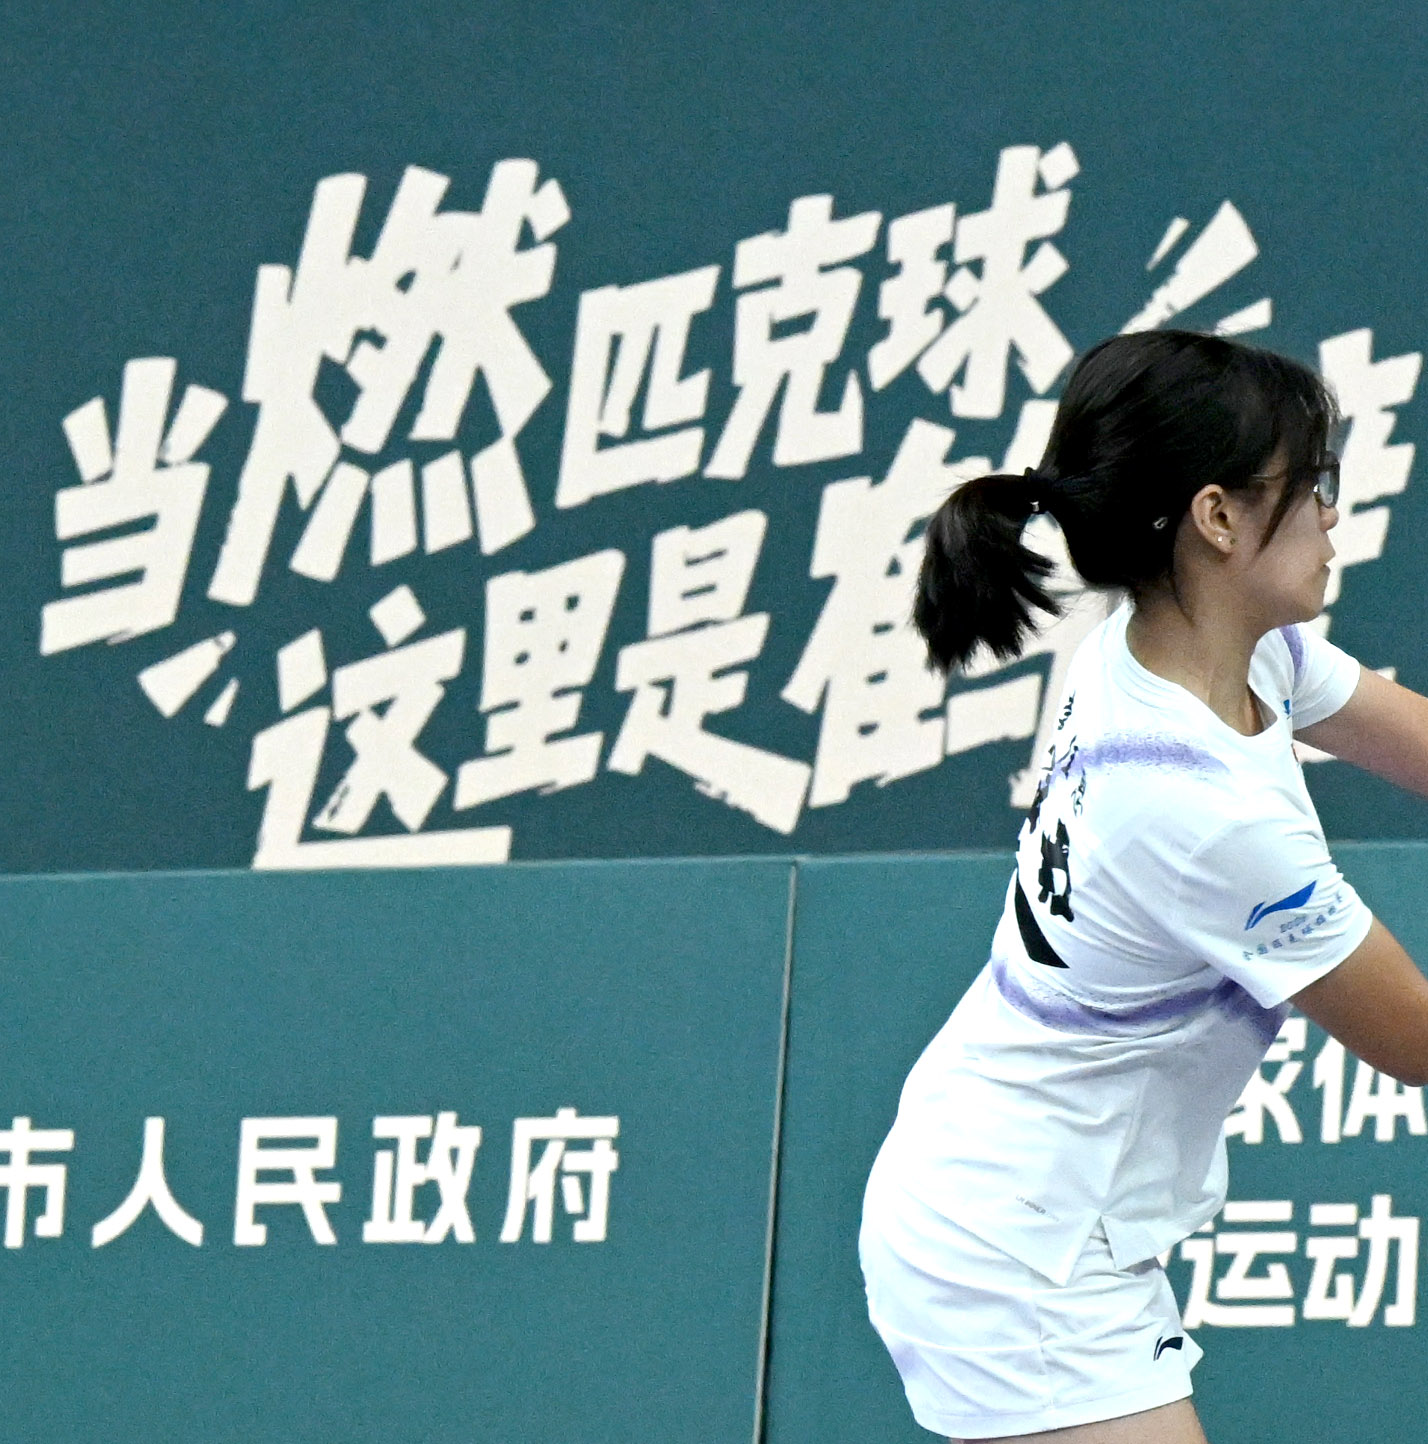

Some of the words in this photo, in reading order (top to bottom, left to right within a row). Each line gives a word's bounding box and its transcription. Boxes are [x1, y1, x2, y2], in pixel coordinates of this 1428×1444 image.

[40, 142, 1080, 656] 当燃匹克球
[248, 328, 1422, 871] 这里是鹤
[0, 1107, 620, 1249] 市人民政府
